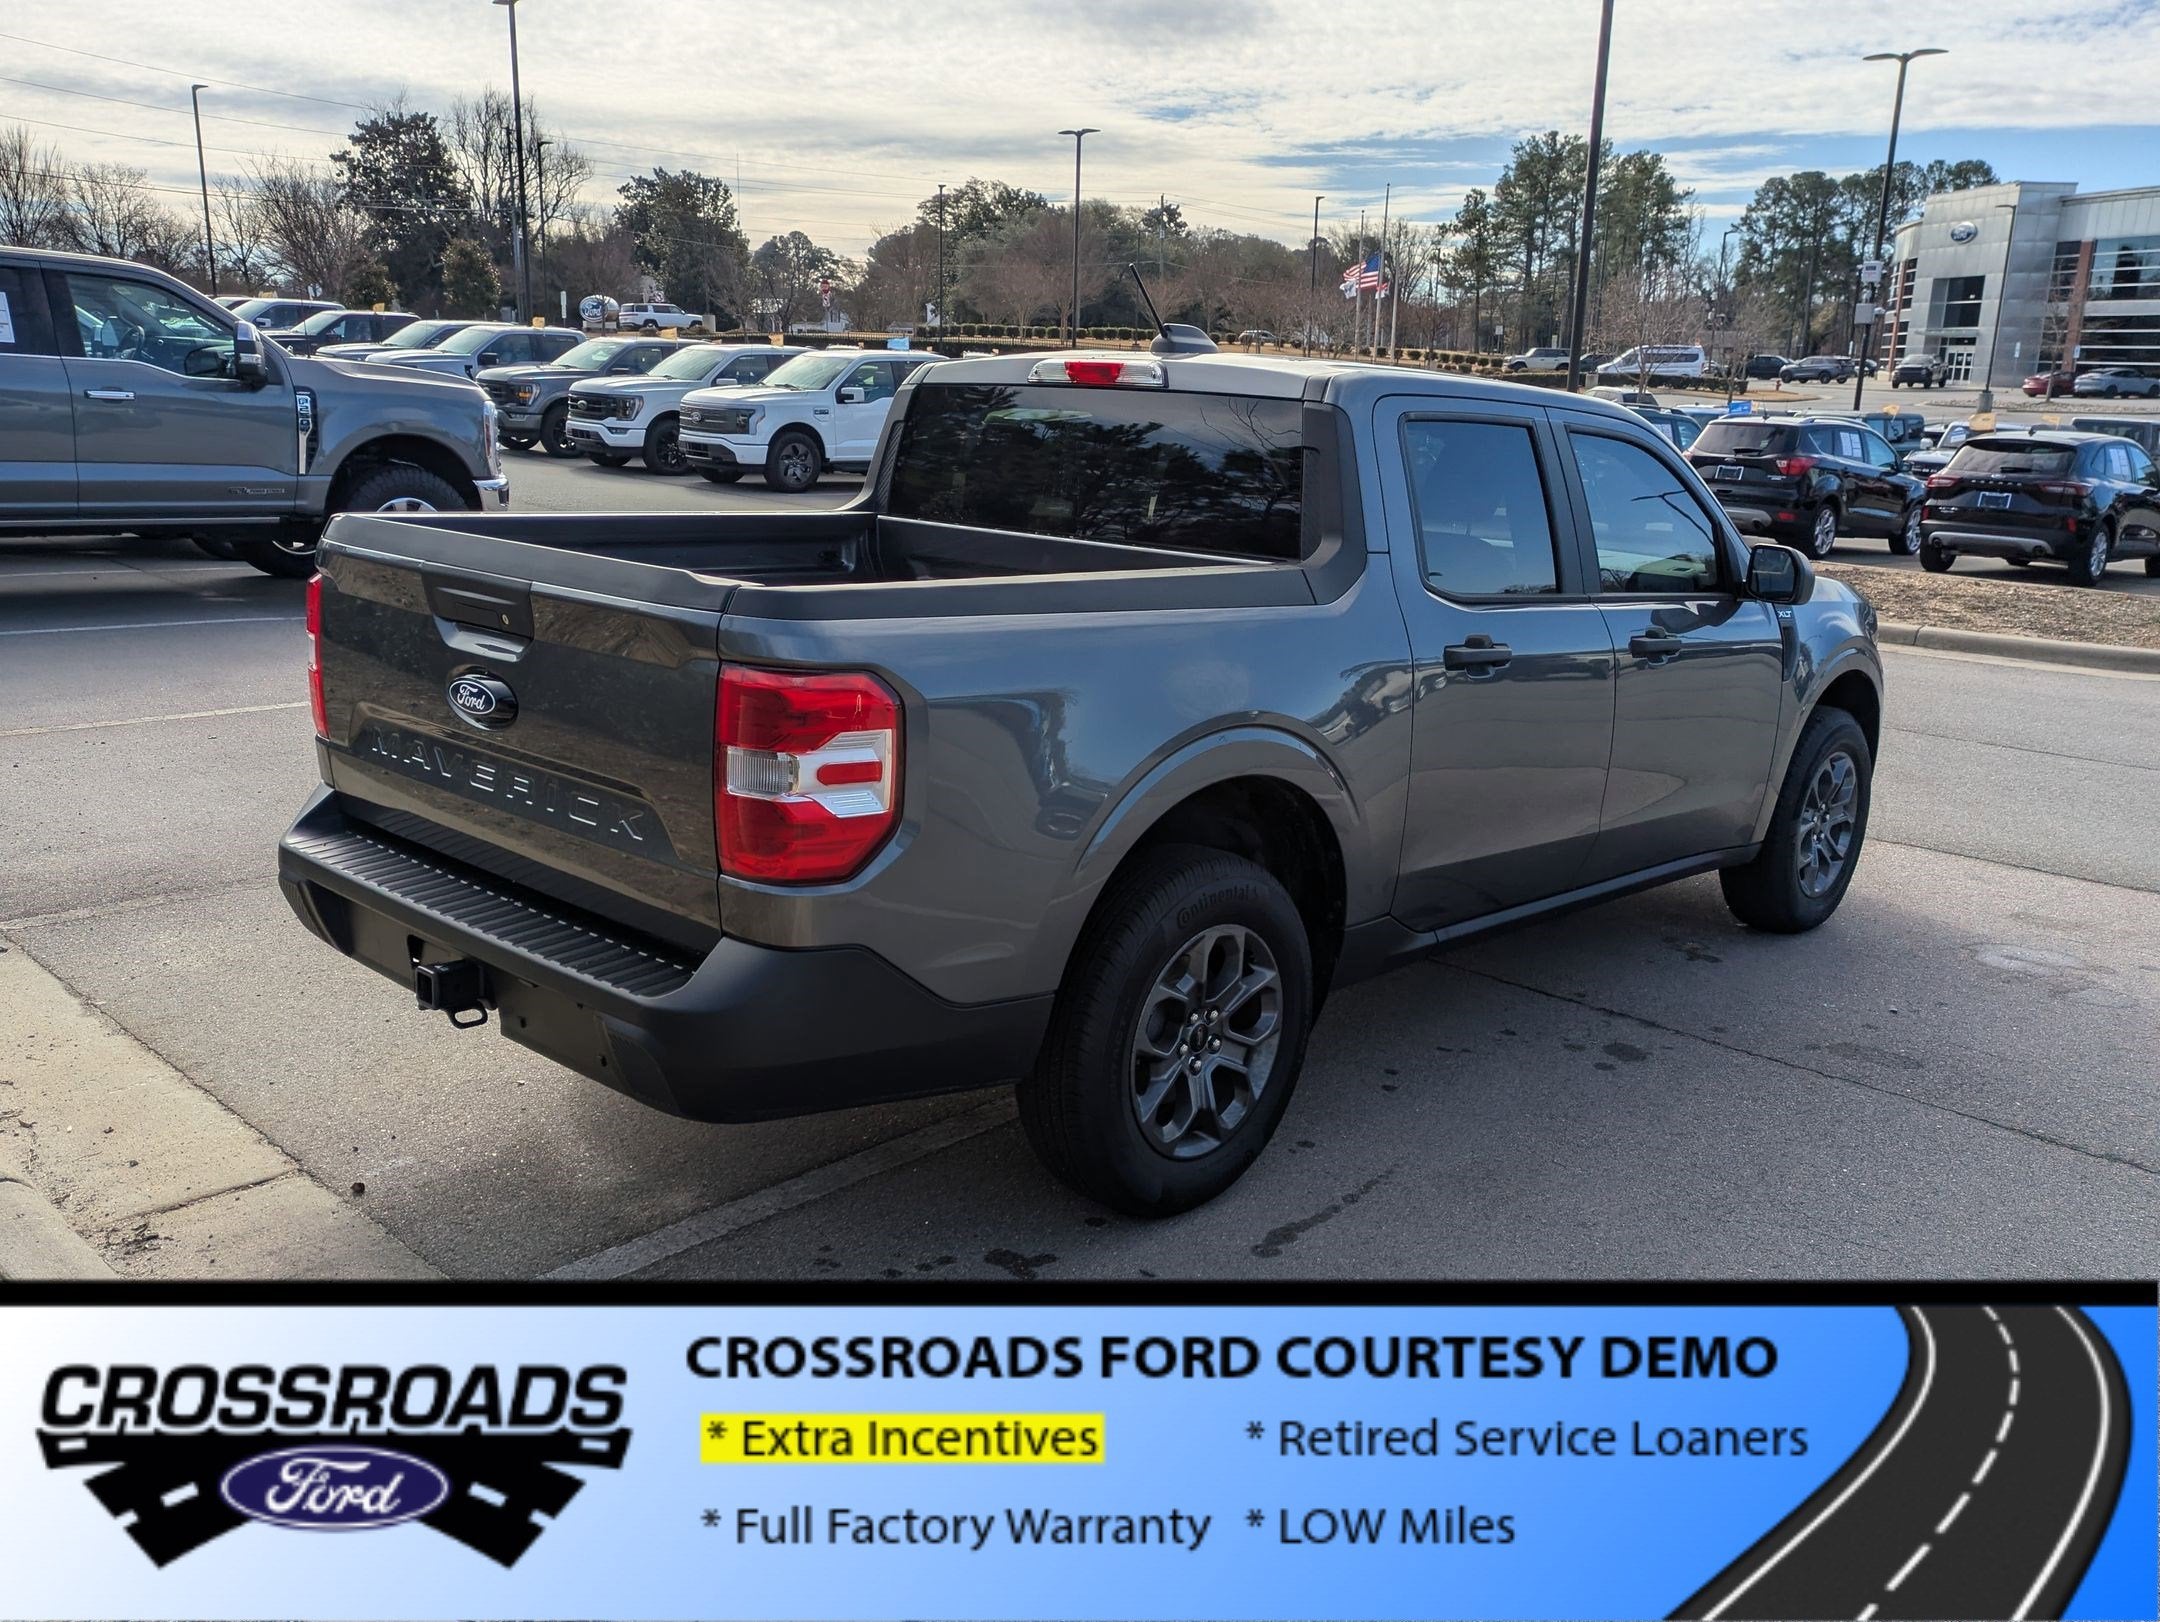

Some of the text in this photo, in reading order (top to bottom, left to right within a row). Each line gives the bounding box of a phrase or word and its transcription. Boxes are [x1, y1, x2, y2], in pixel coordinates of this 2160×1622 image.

[1777, 610, 1792, 618] XLT
[456, 683, 487, 711] Ford
[371, 727, 645, 841] MAVERICK
[1177, 883, 1249, 930] Continental
